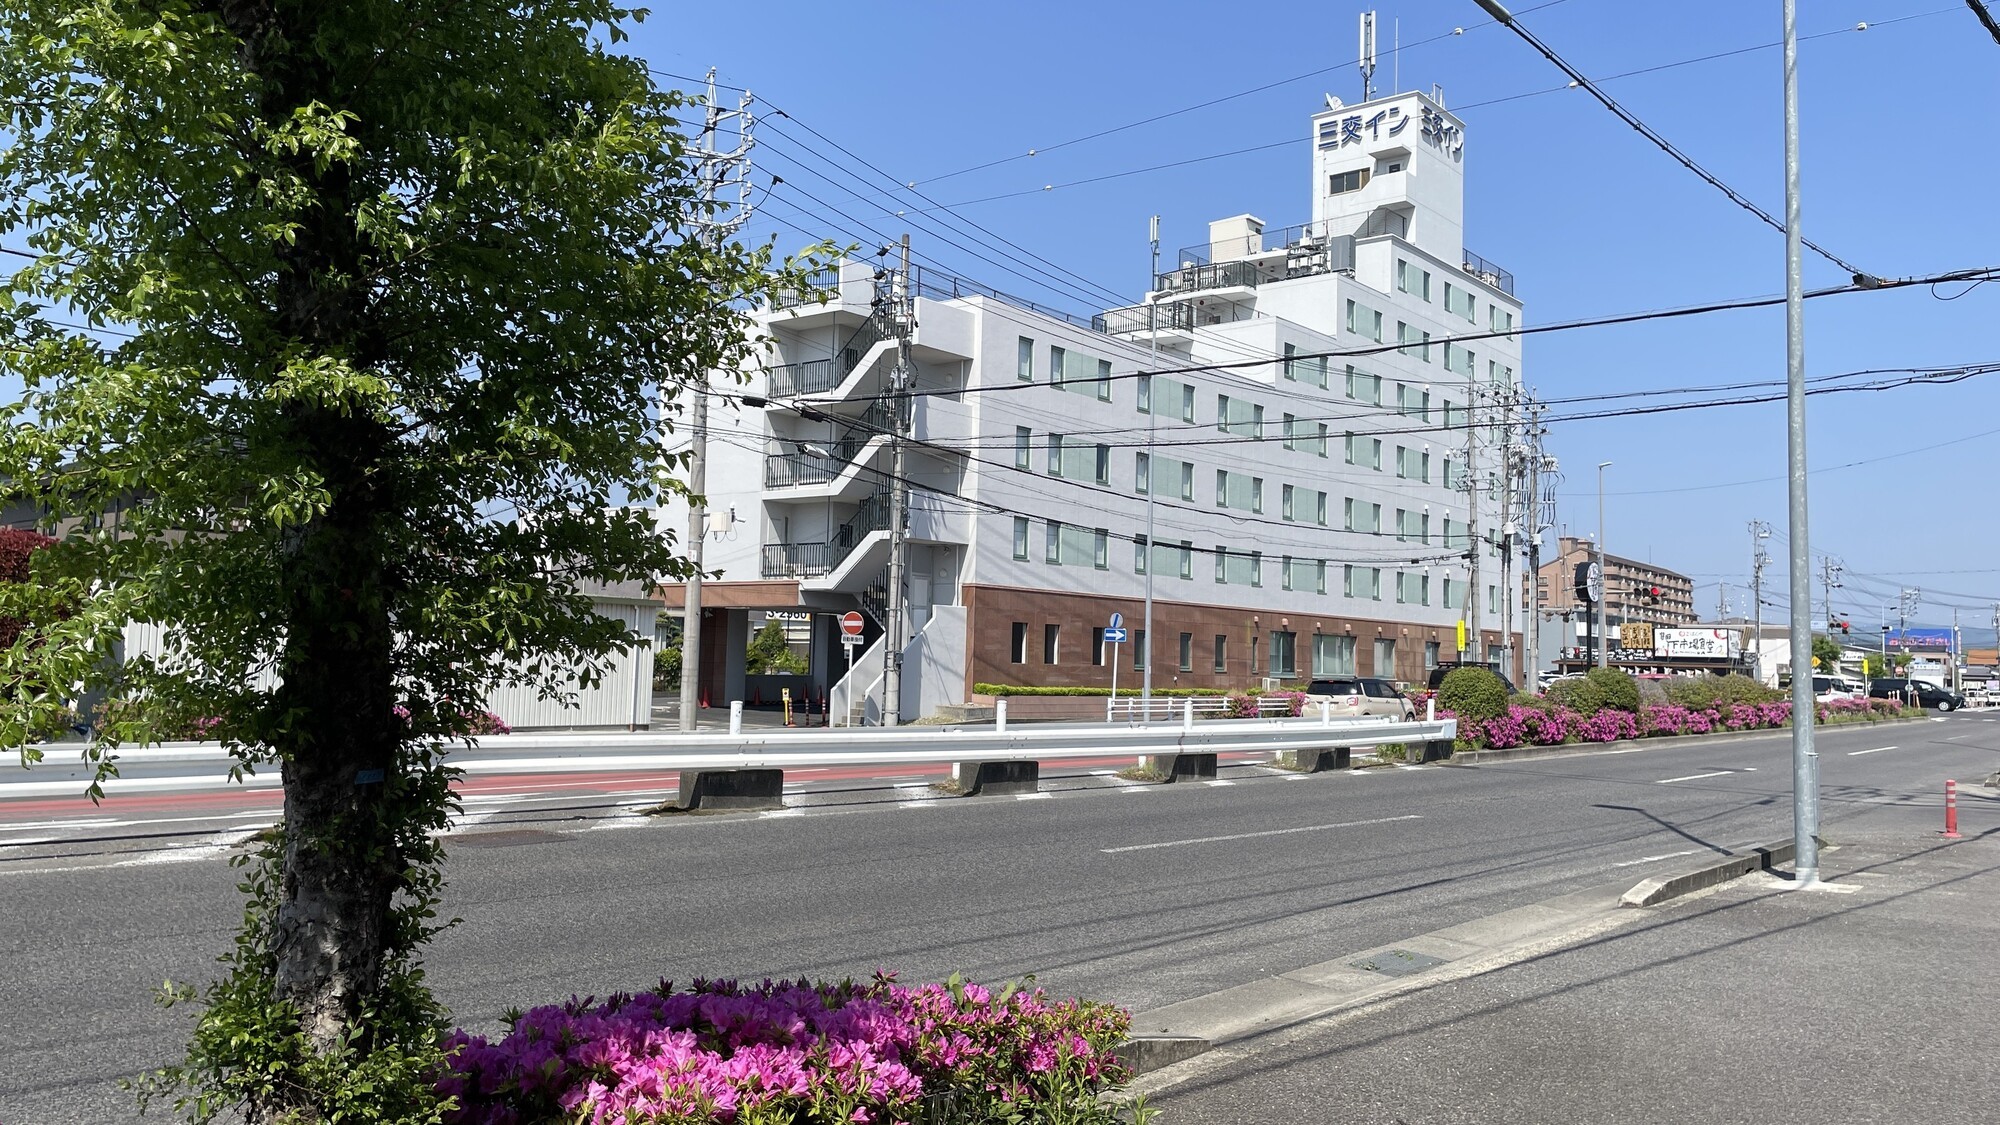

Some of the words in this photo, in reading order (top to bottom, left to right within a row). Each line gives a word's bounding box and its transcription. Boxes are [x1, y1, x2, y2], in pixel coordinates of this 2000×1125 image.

[1318, 106, 1410, 150] 三交イン
[1421, 105, 1463, 152] 三交イン
